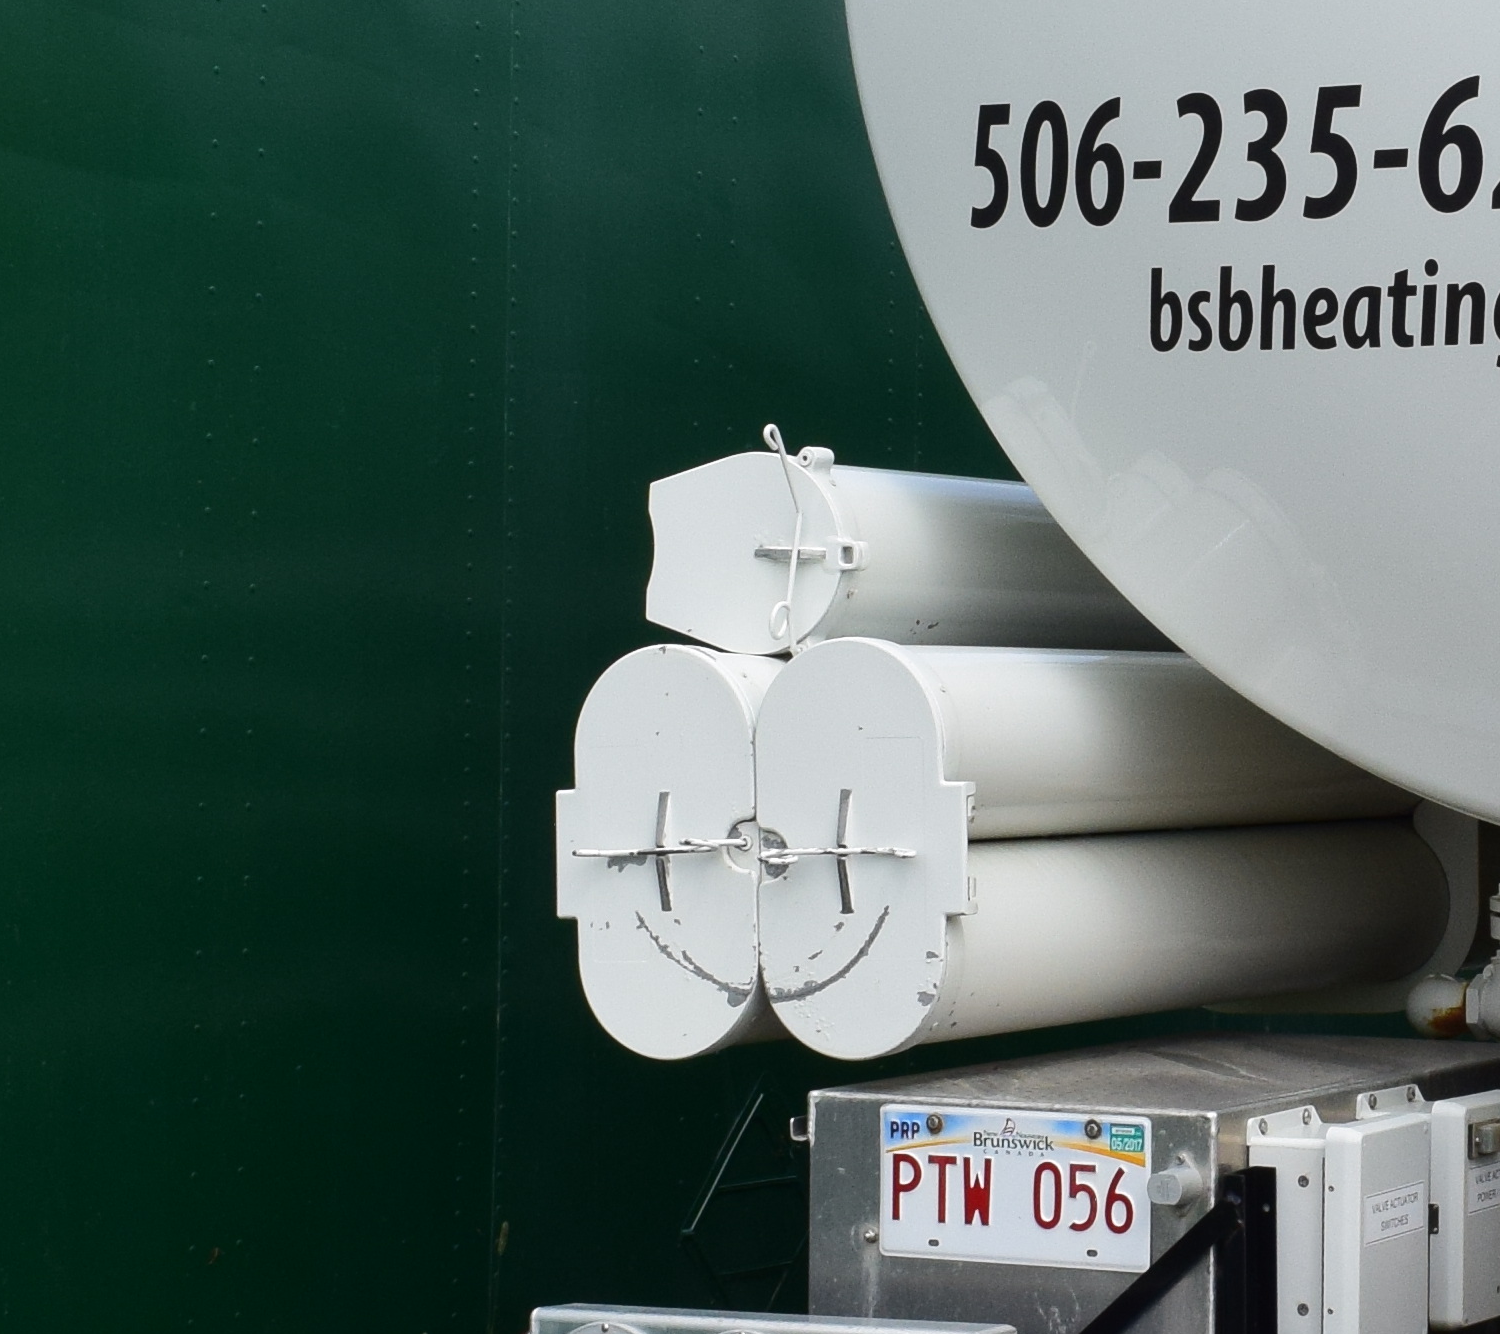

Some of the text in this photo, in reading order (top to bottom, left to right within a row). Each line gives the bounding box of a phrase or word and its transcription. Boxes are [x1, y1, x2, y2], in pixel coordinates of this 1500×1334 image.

[890, 1120, 921, 1140] PRP
[973, 1131, 1055, 1152] Brunswick
[1111, 1137, 1143, 1152] 05/2017
[892, 1152, 1134, 1234] PTW 056
